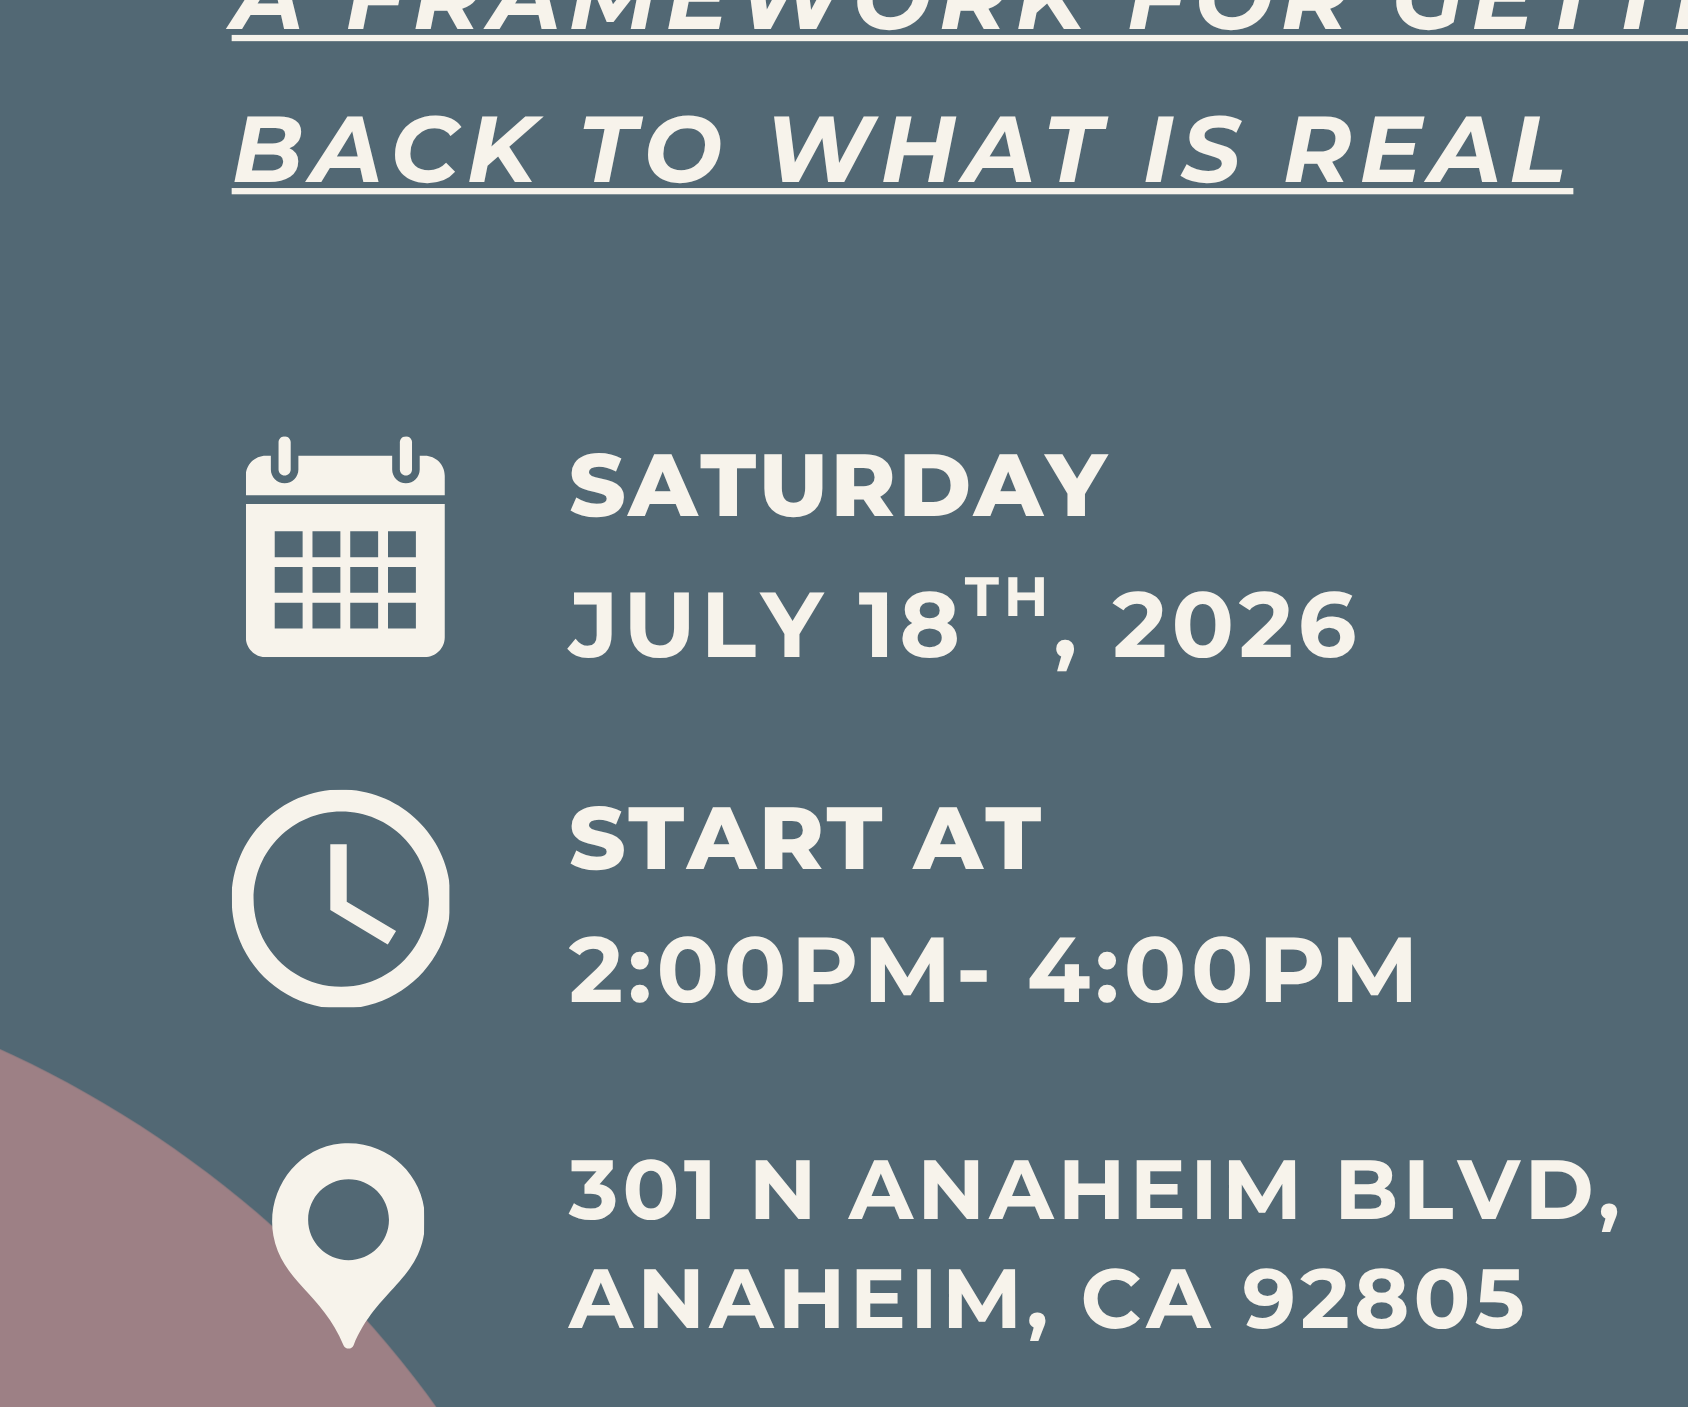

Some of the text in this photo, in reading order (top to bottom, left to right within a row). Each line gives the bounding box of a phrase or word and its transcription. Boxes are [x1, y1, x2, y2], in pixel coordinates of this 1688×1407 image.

[234, 115, 1562, 184] BACK TO WHAT IS REAL
[570, 453, 1109, 518] SATURDAY
[567, 592, 825, 658] JULY
[1112, 591, 1355, 658] 2026
[570, 806, 1041, 871] START AT
[569, 936, 1411, 1003] 2:00PM- 4:00PM
[568, 1159, 1618, 1232] 301 N ANAHEIM BLVD,
[568, 1268, 1523, 1341] ANAHEIM, CA 92805
